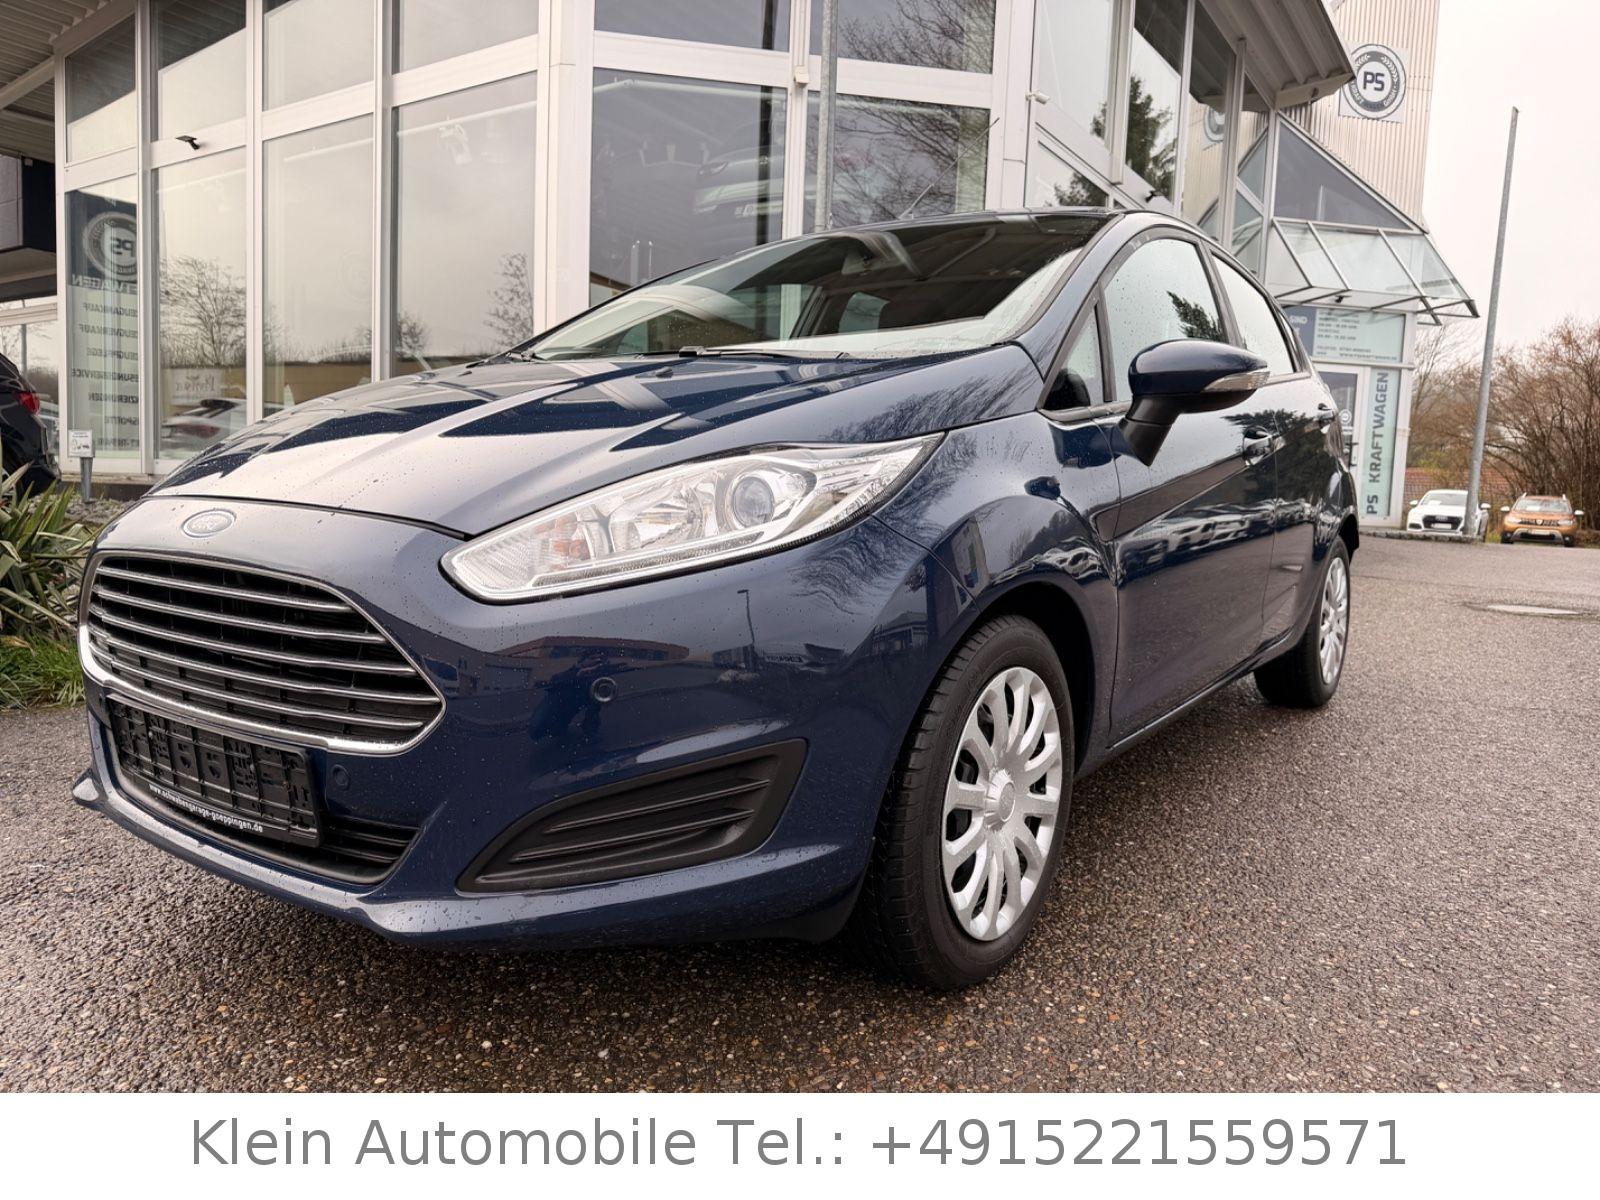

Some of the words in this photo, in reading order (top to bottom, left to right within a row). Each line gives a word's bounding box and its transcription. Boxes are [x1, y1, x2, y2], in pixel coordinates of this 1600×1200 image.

[1363, 71, 1385, 92] PS
[1369, 372, 1388, 483] KRAFTWAGEN
[1366, 495, 1378, 514] PS
